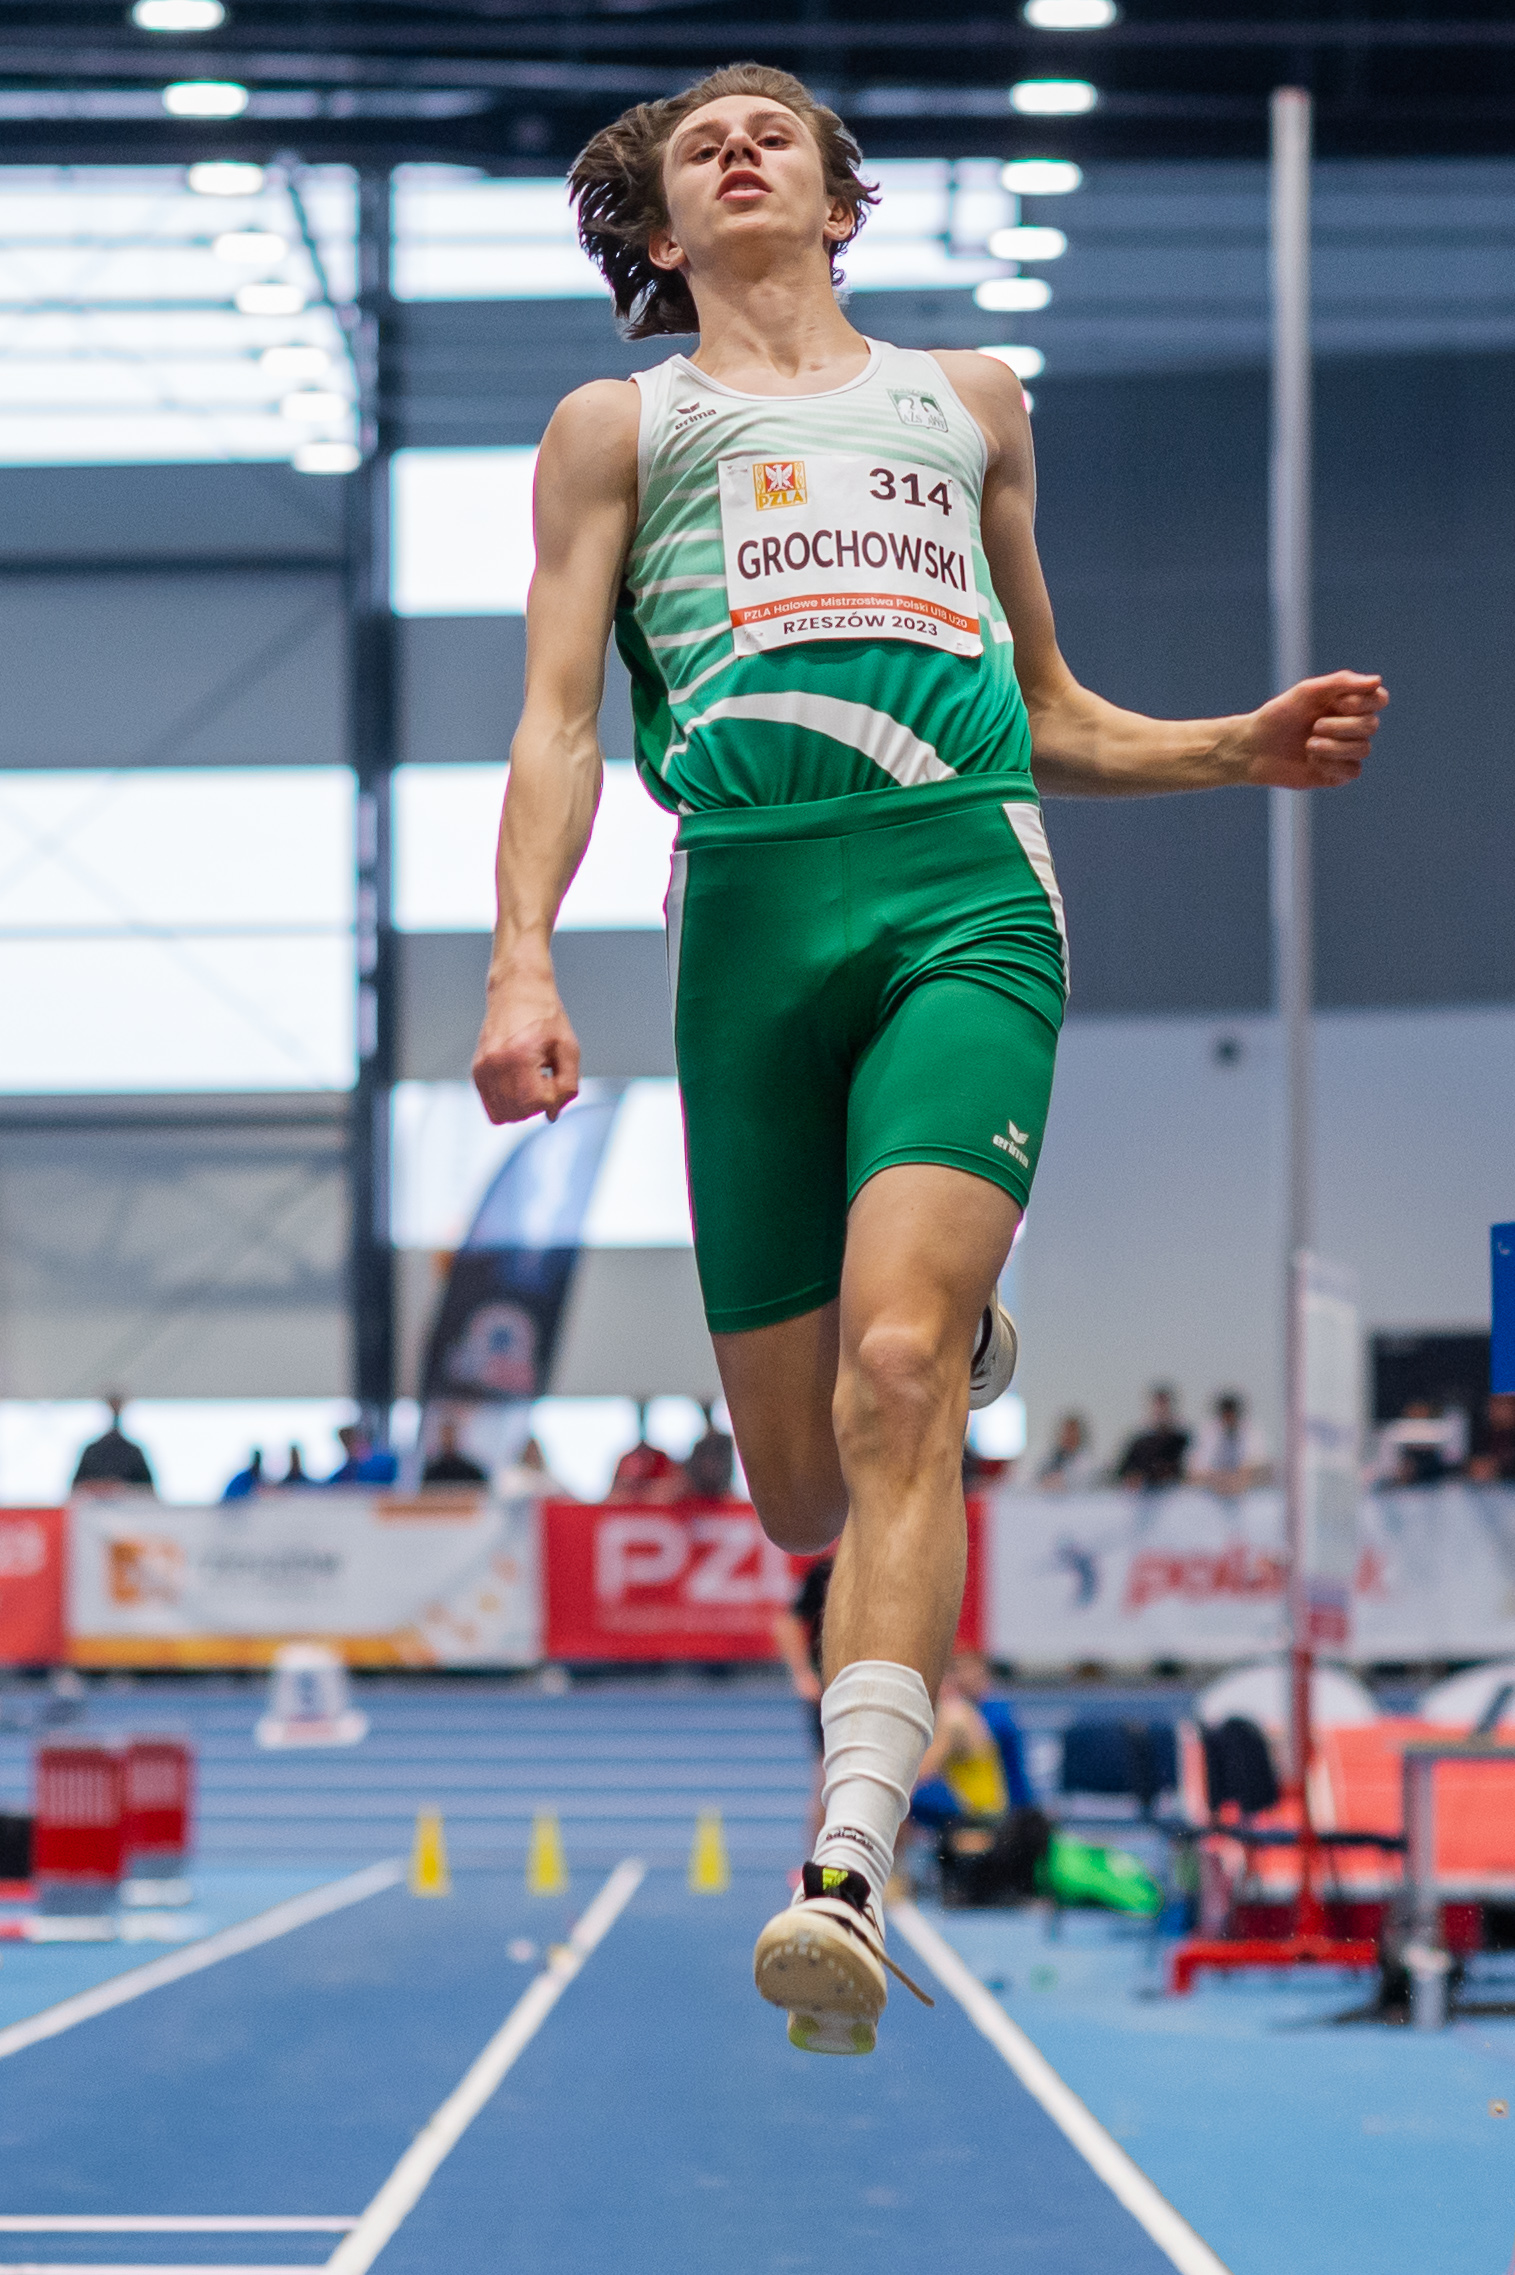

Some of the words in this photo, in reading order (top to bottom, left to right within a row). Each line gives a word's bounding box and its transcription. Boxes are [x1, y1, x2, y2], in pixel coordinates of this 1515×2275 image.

[674, 409, 717, 430] erima
[758, 490, 804, 509] PZLA
[869, 467, 953, 517] 314
[737, 529, 967, 592] GROCHOWSKI
[743, 607, 772, 621] PZLA
[773, 599, 819, 615] Halowe
[820, 596, 894, 608] Mistrzostwa
[896, 598, 929, 613] Polski
[930, 606, 948, 621] U18
[948, 613, 968, 629] U20
[783, 610, 886, 635] RZESZÓW
[892, 615, 938, 636] 2023
[991, 1133, 1030, 1170] erima
